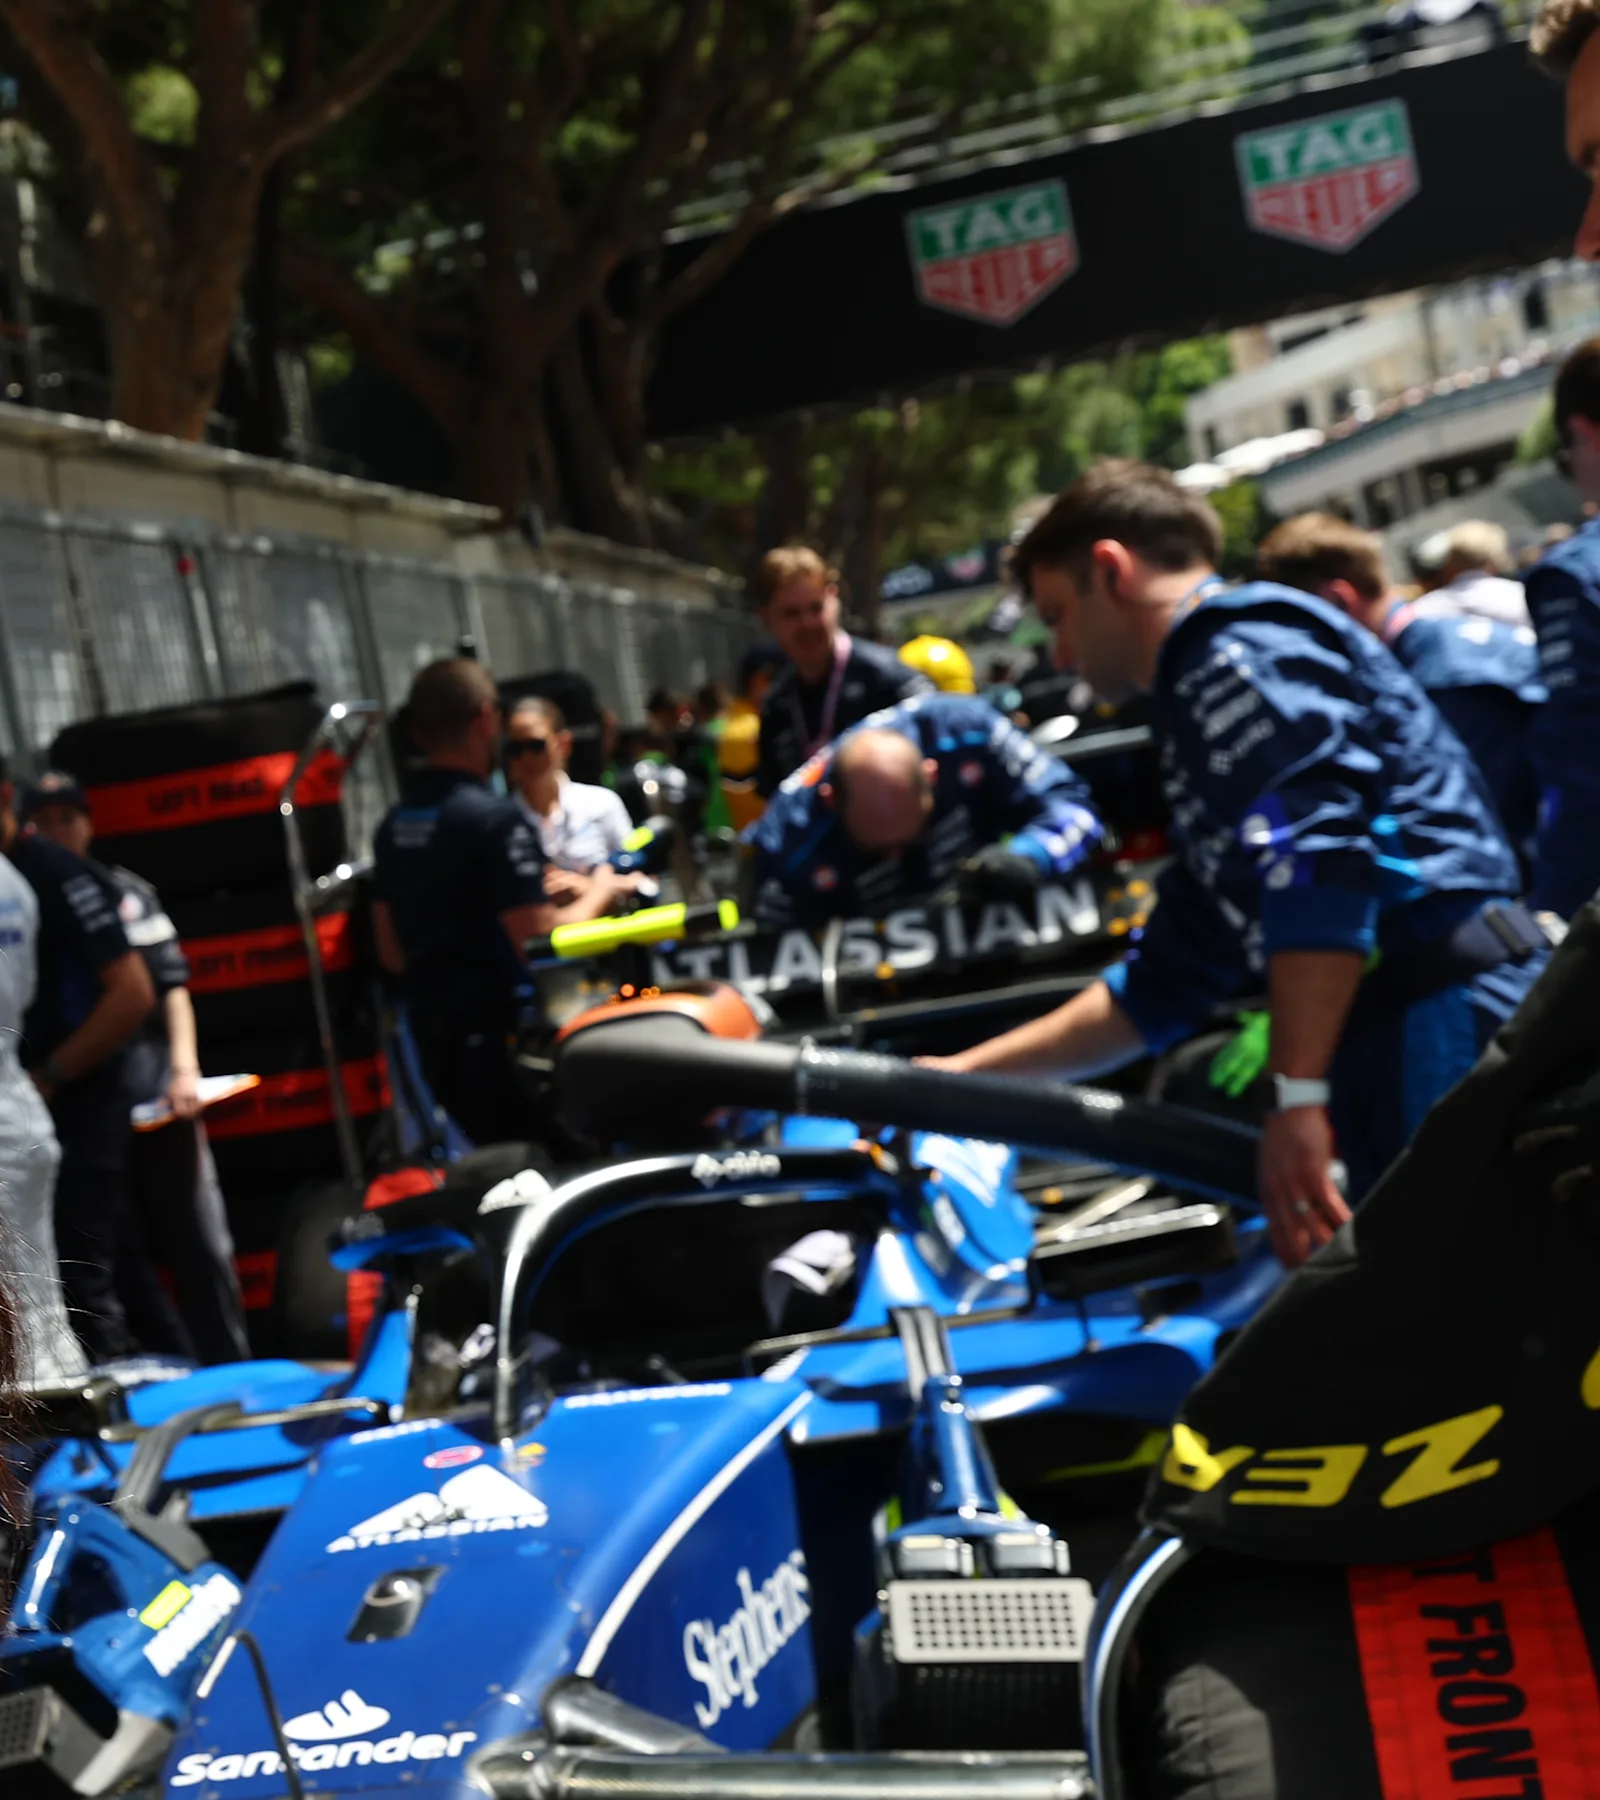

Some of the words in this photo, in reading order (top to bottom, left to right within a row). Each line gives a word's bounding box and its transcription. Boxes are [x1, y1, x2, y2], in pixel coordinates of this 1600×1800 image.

[1255, 110, 1393, 178] TAG
[924, 189, 1054, 256] TAG
[326, 1512, 549, 1554] ATLASSIAN
[683, 1548, 811, 1730] Stephens
